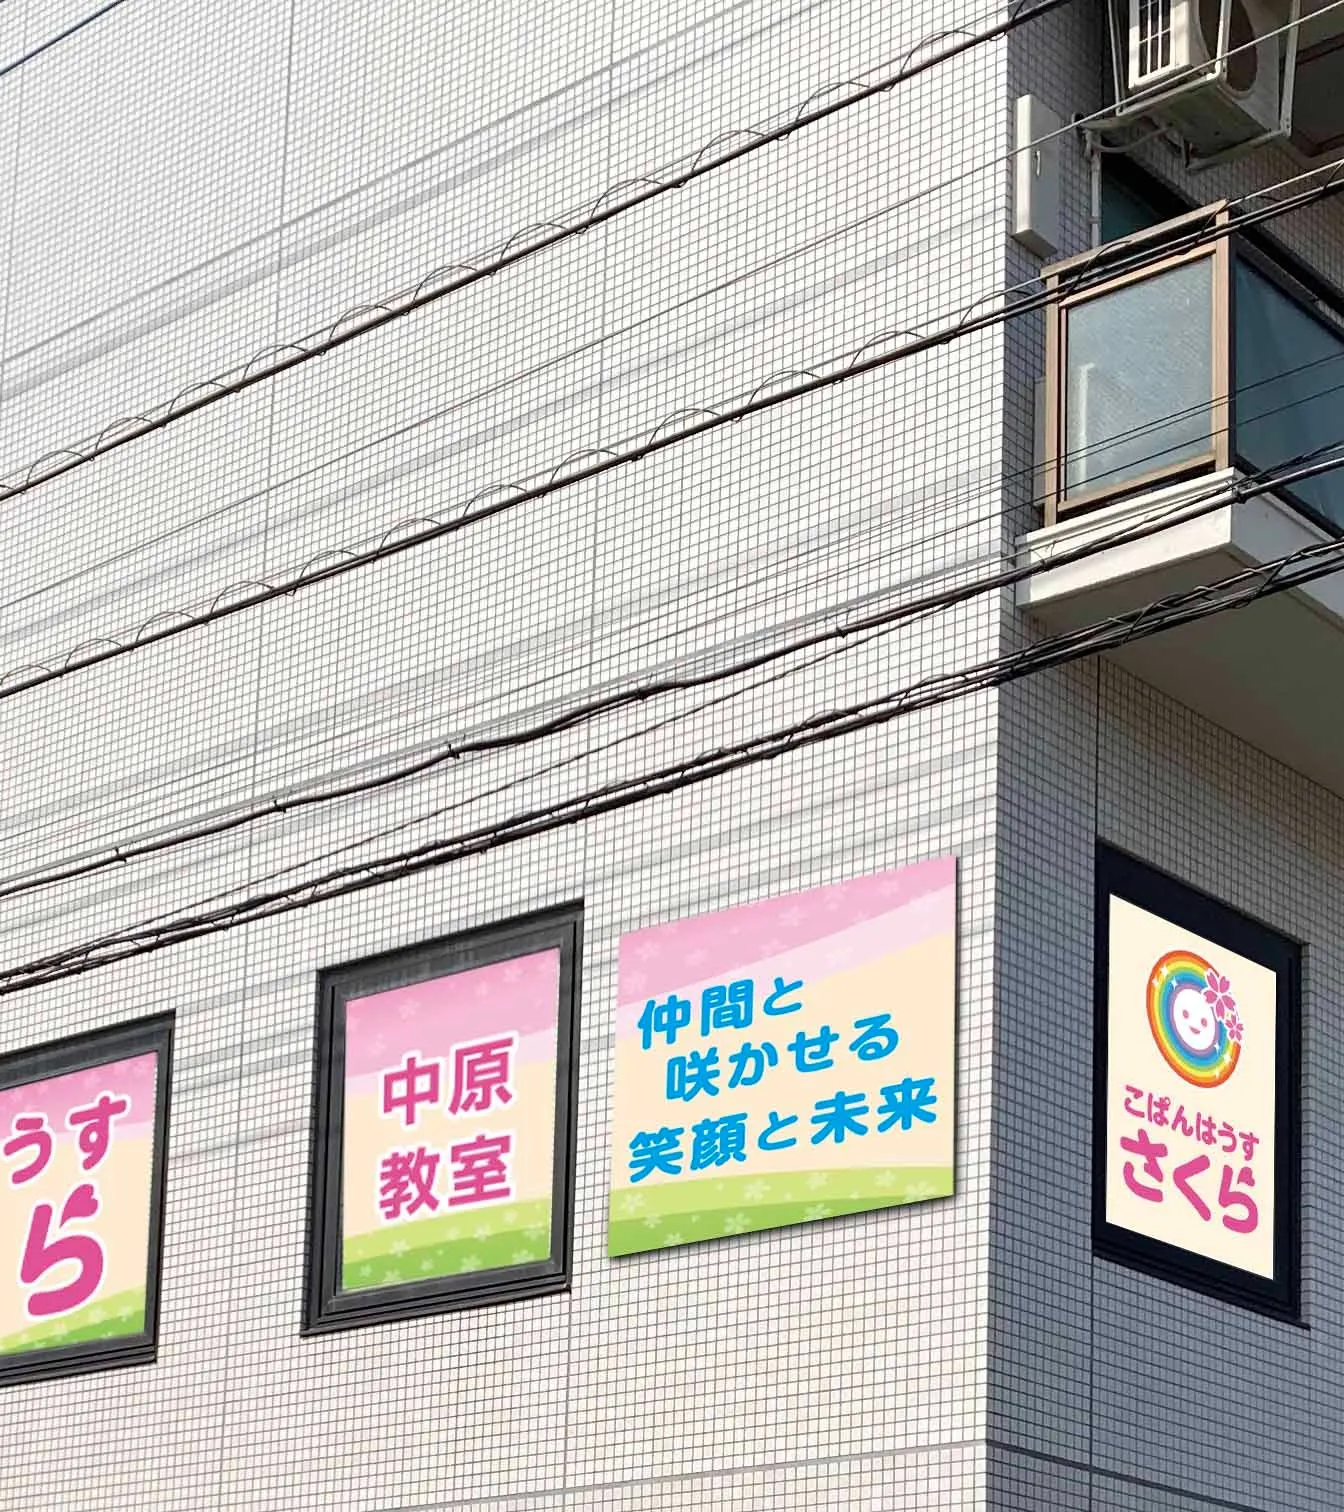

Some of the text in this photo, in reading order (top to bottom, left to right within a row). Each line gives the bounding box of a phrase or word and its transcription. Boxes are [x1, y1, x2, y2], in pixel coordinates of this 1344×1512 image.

[637, 976, 804, 1051] 仲間と
[665, 1012, 900, 1103] 咲かせる
[382, 1037, 513, 1126] 中原
[1123, 1085, 1260, 1162] こぱんはうす
[629, 1077, 938, 1183] 笑顔と未来
[379, 1134, 512, 1220] 教室
[1120, 1128, 1259, 1235] さくら
